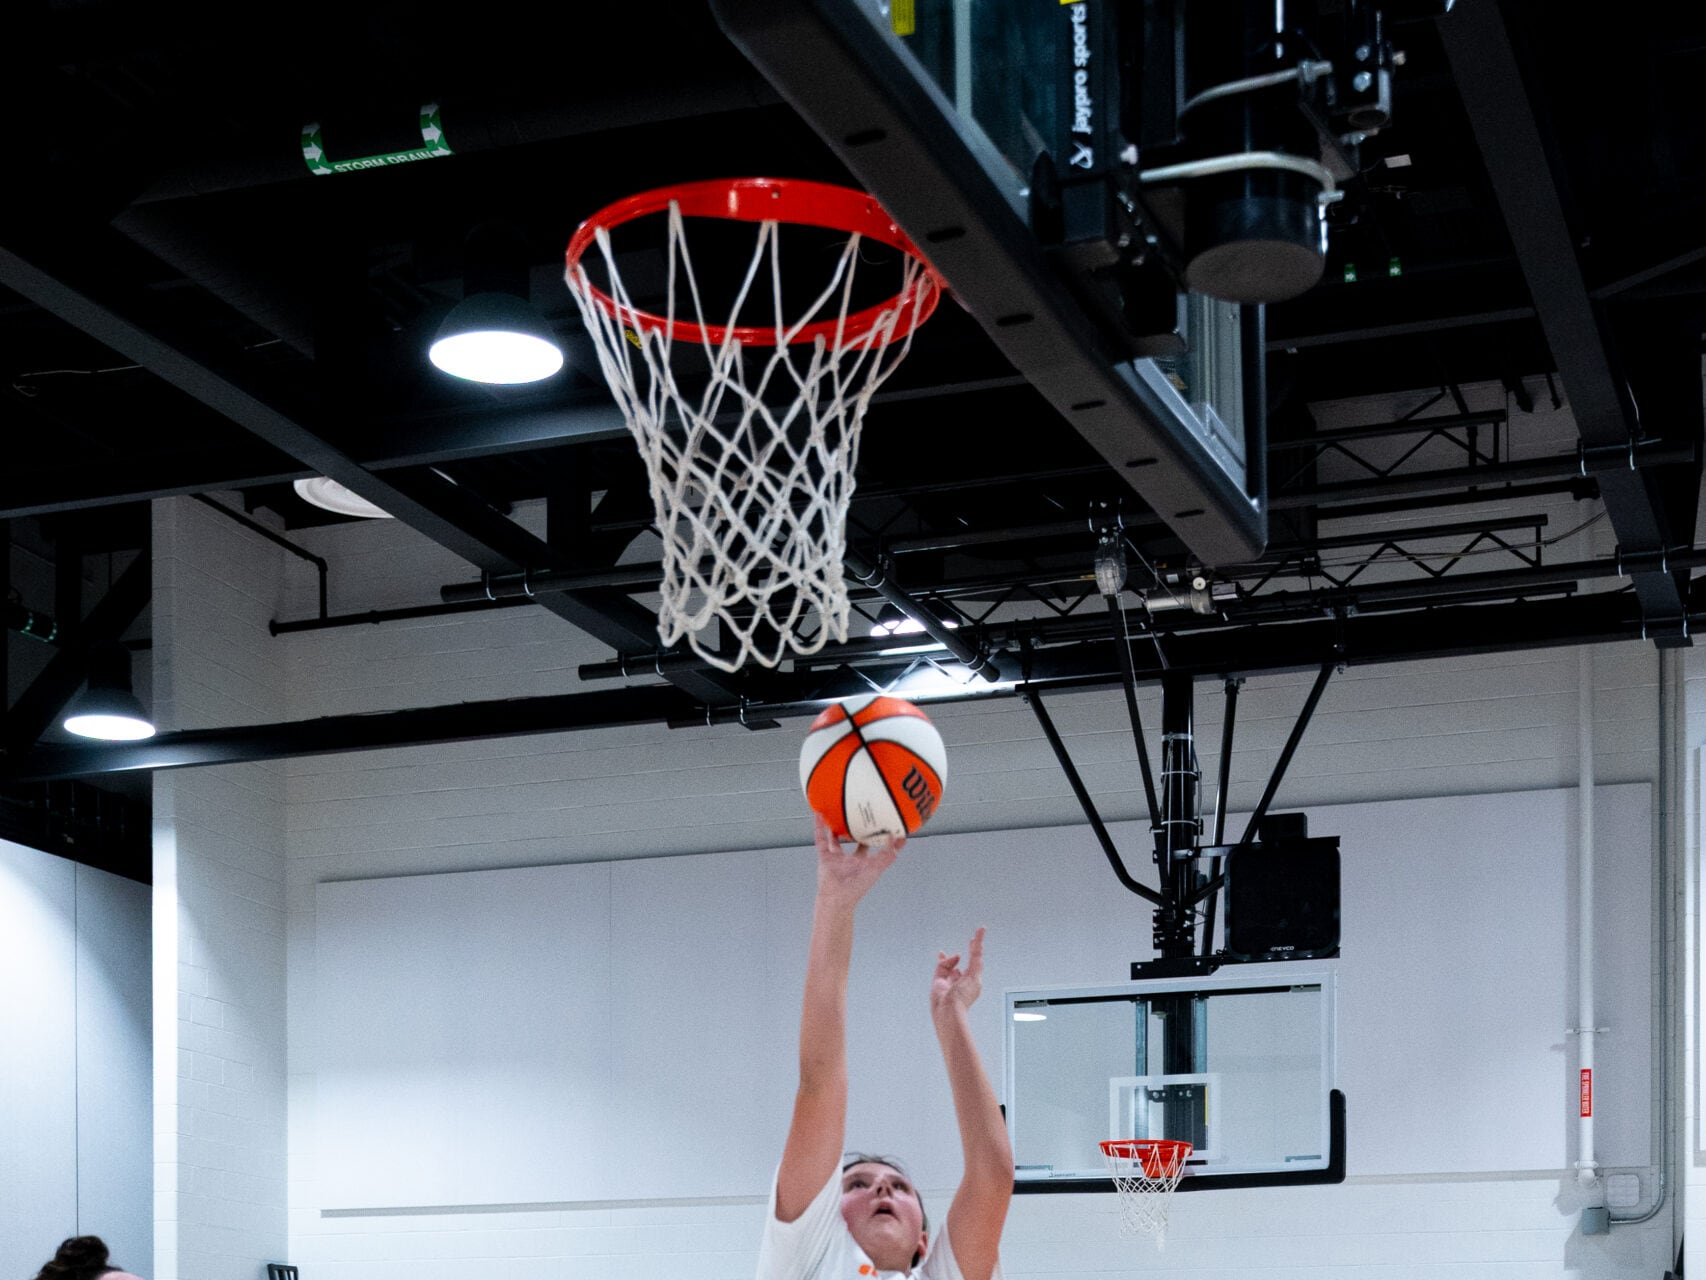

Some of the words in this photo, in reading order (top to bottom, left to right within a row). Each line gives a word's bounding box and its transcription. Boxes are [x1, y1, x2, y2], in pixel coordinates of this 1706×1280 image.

[1071, 3, 1091, 67] sports
[1072, 69, 1092, 134] jaypro
[334, 158, 386, 172] STORM
[387, 151, 434, 164] DRAIN
